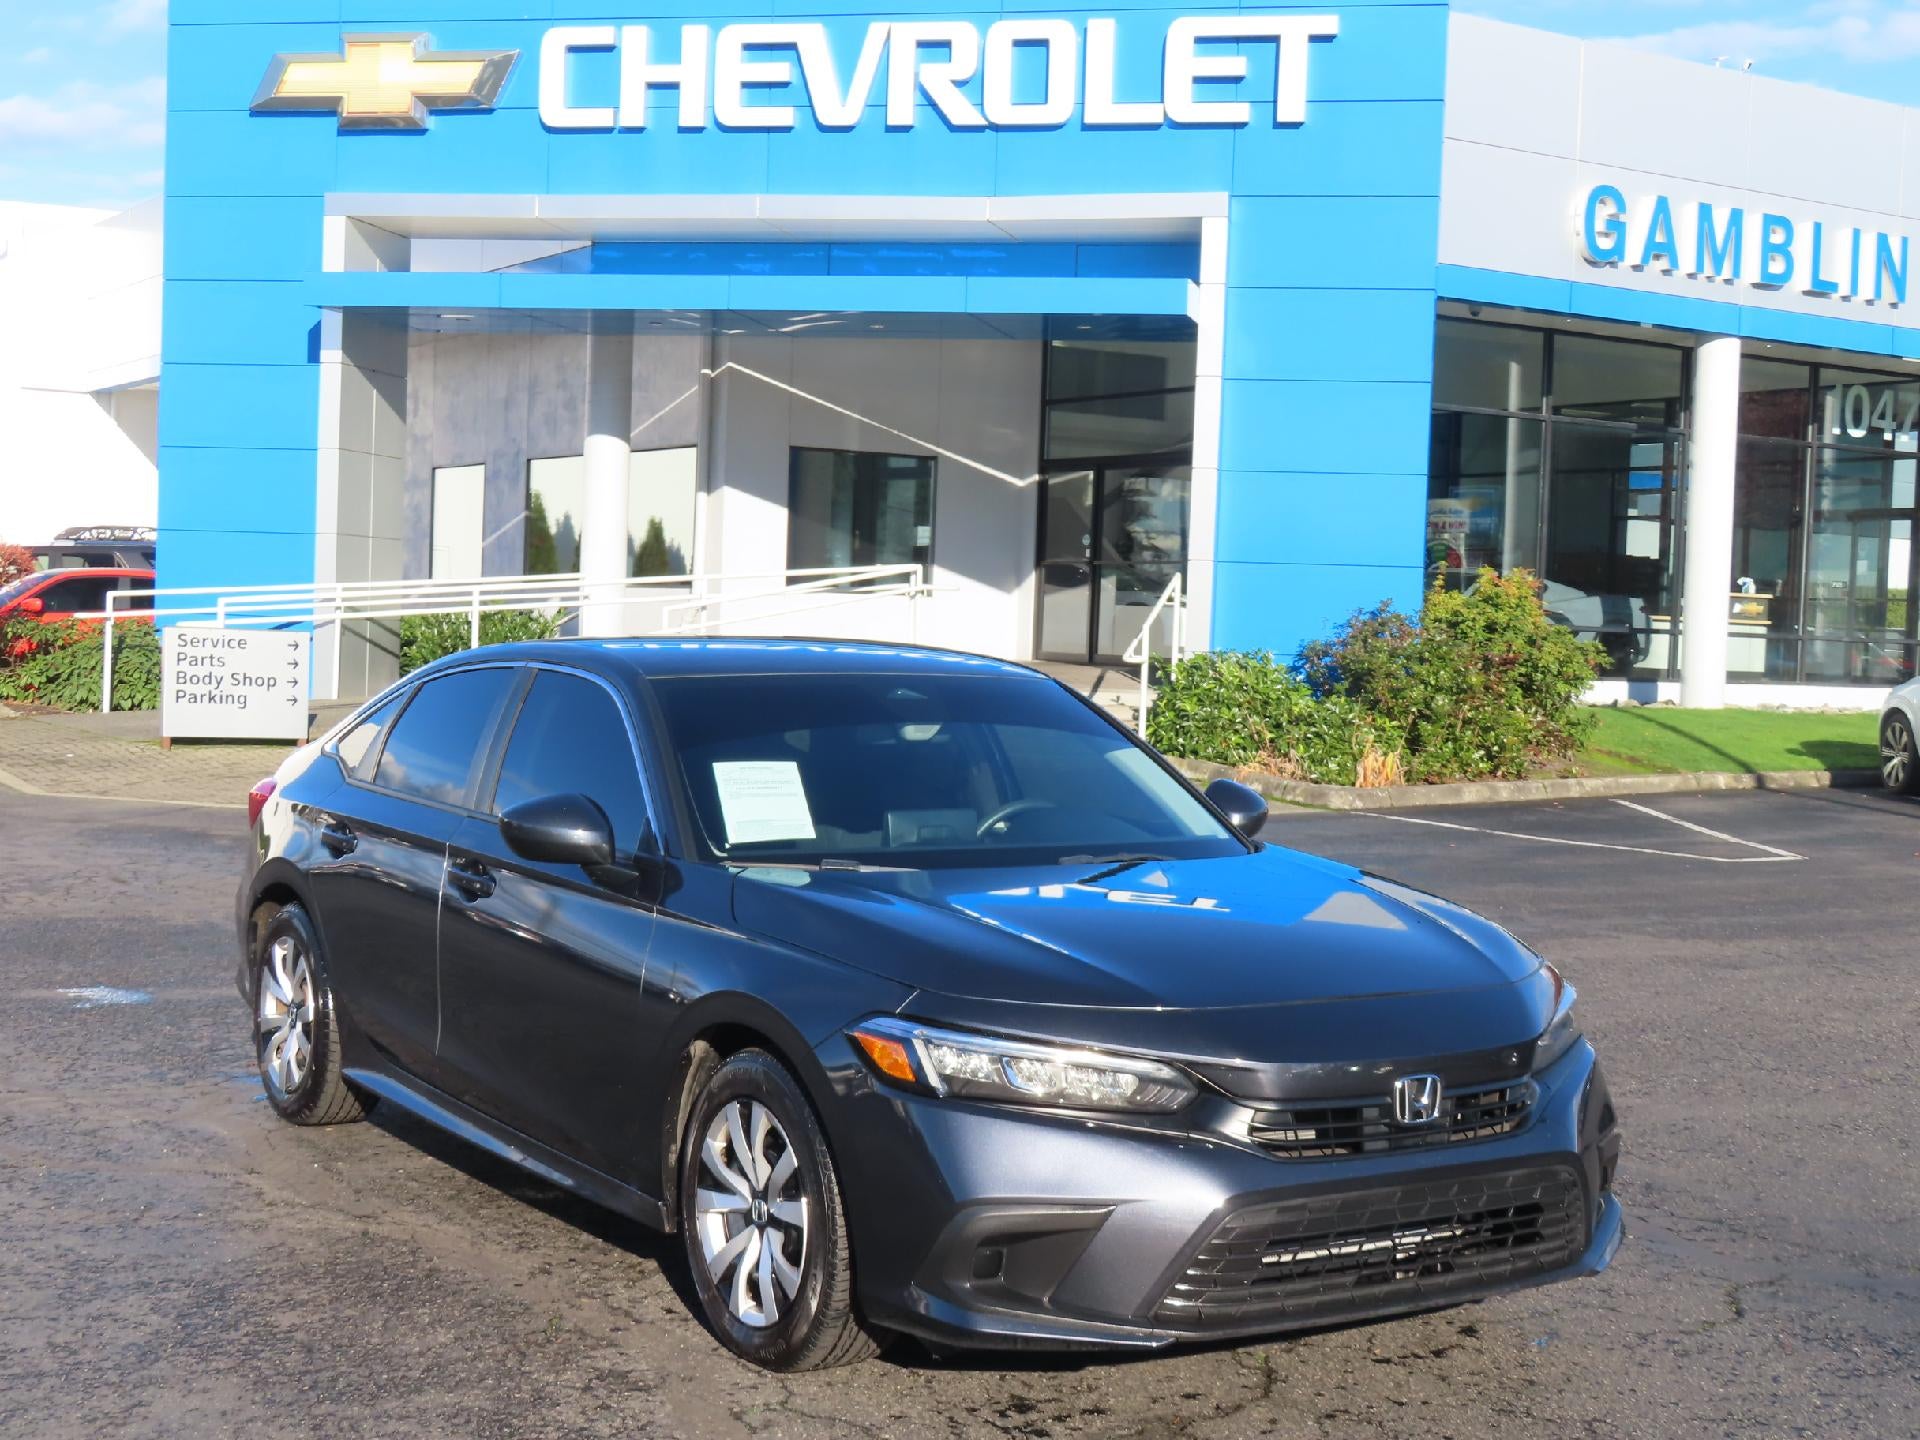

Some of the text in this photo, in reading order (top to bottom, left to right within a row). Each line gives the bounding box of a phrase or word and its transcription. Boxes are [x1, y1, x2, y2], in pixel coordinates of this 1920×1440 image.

[538, 15, 1339, 128] CHEVROLET
[1582, 184, 1909, 306] GAMBLIN
[1827, 384, 1920, 442] 1047
[177, 633, 247, 649] Service
[176, 652, 225, 667] Parts
[176, 671, 277, 691] Body Shop
[175, 690, 247, 709] Parking
